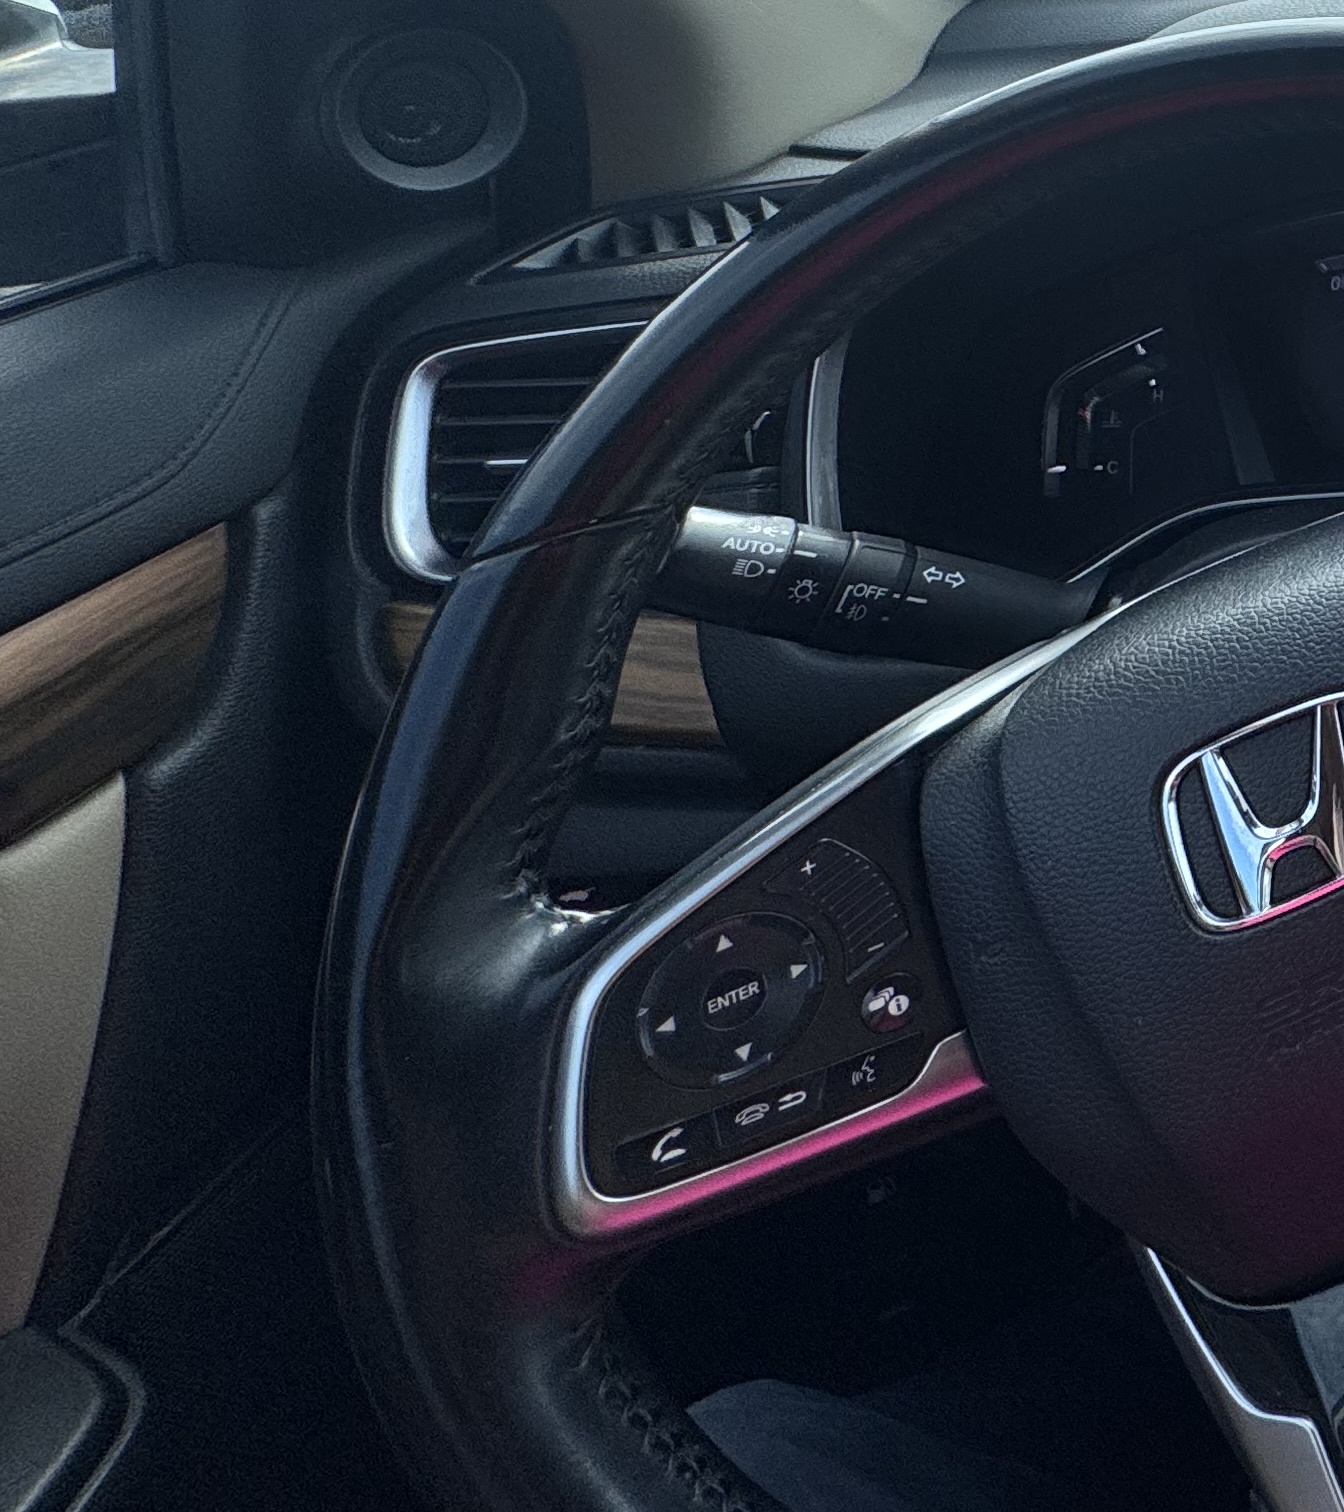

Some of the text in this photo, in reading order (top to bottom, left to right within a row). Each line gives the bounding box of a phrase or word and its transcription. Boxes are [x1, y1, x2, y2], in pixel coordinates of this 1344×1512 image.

[1330, 276, 1341, 291] 0
[1106, 460, 1119, 475] C
[722, 537, 775, 556] AUTO
[852, 582, 888, 601] OFF
[707, 980, 761, 1014] ENTER
